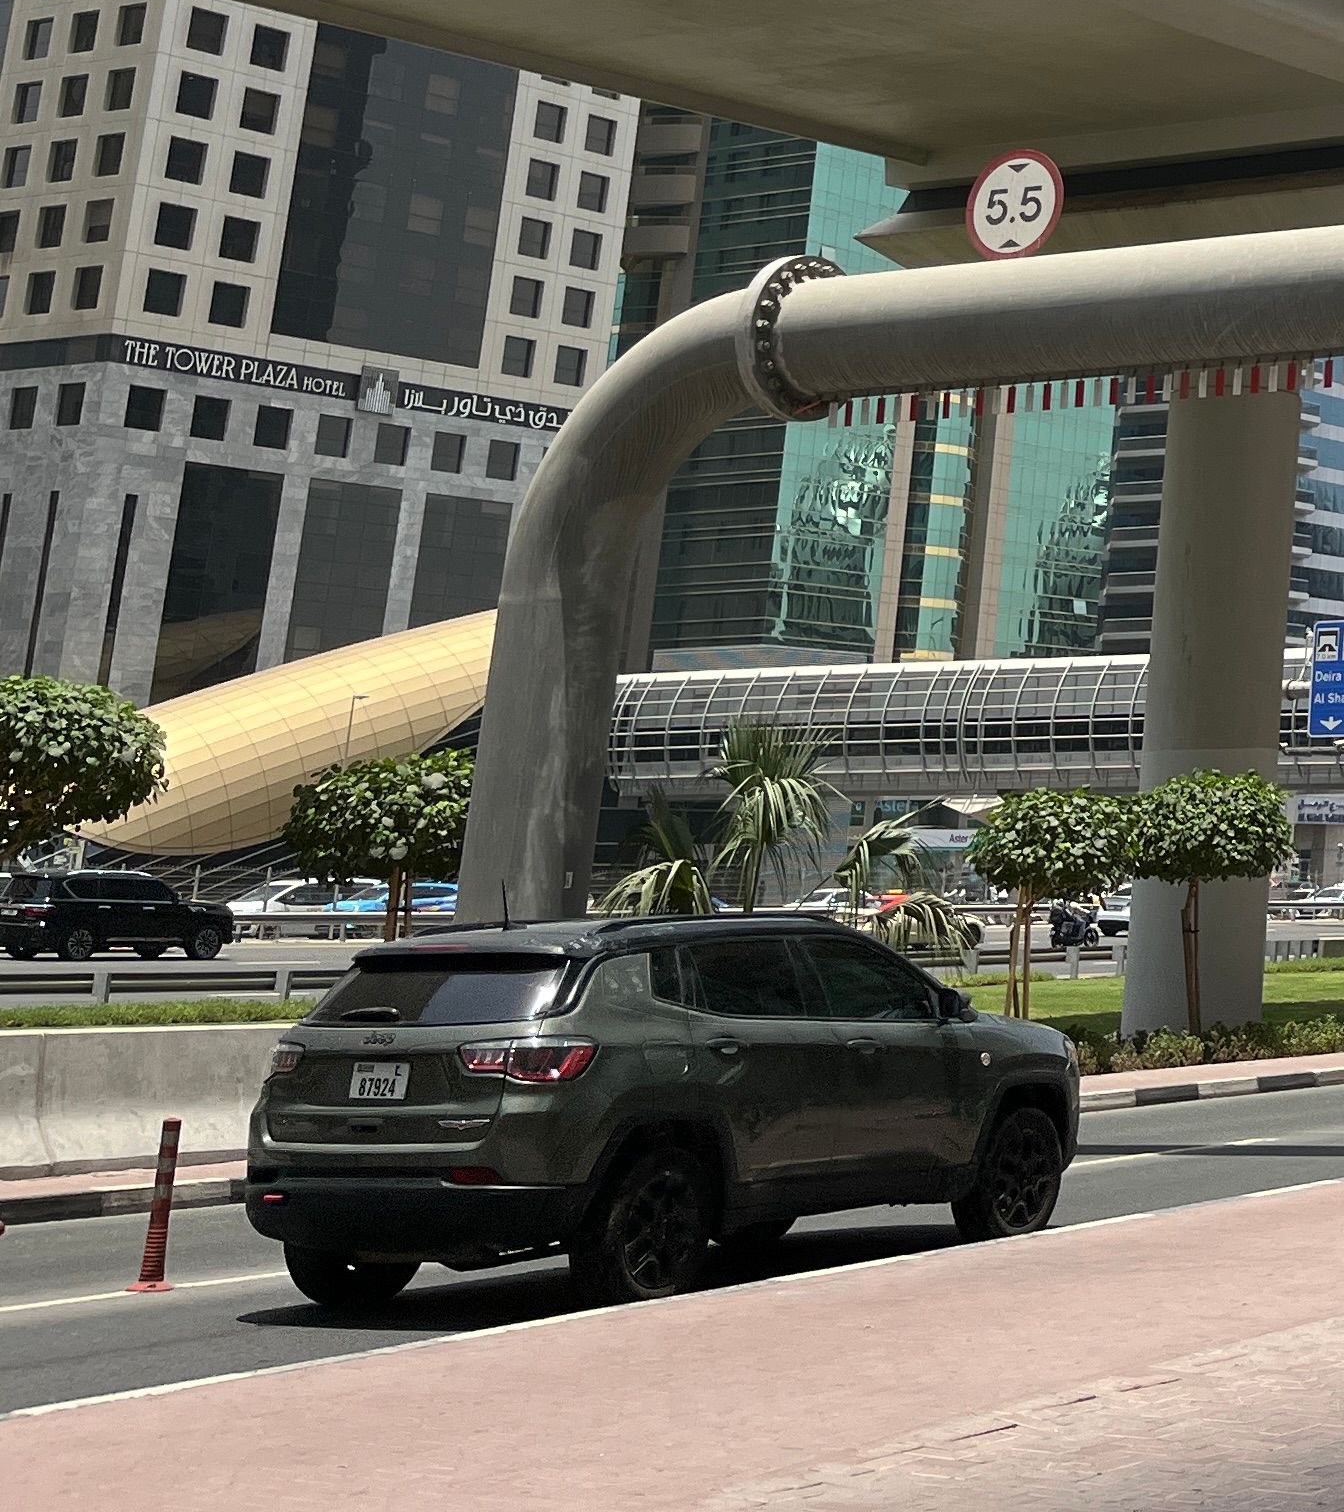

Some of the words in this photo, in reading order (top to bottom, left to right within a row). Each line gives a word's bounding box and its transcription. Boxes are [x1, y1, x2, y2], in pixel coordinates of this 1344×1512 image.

[985, 185, 1043, 226] 5.5
[125, 339, 159, 367] THE
[165, 346, 235, 379] TOWER
[240, 359, 298, 389] PLAZA
[303, 376, 346, 397] HOTEL
[447, 394, 493, 418] تاور
[494, 402, 526, 424] ذي
[528, 406, 573, 430] ندق
[1314, 671, 1342, 683] Deira
[1313, 692, 1325, 705] Al
[395, 1065, 402, 1076] L
[358, 1078, 397, 1097] 87924
